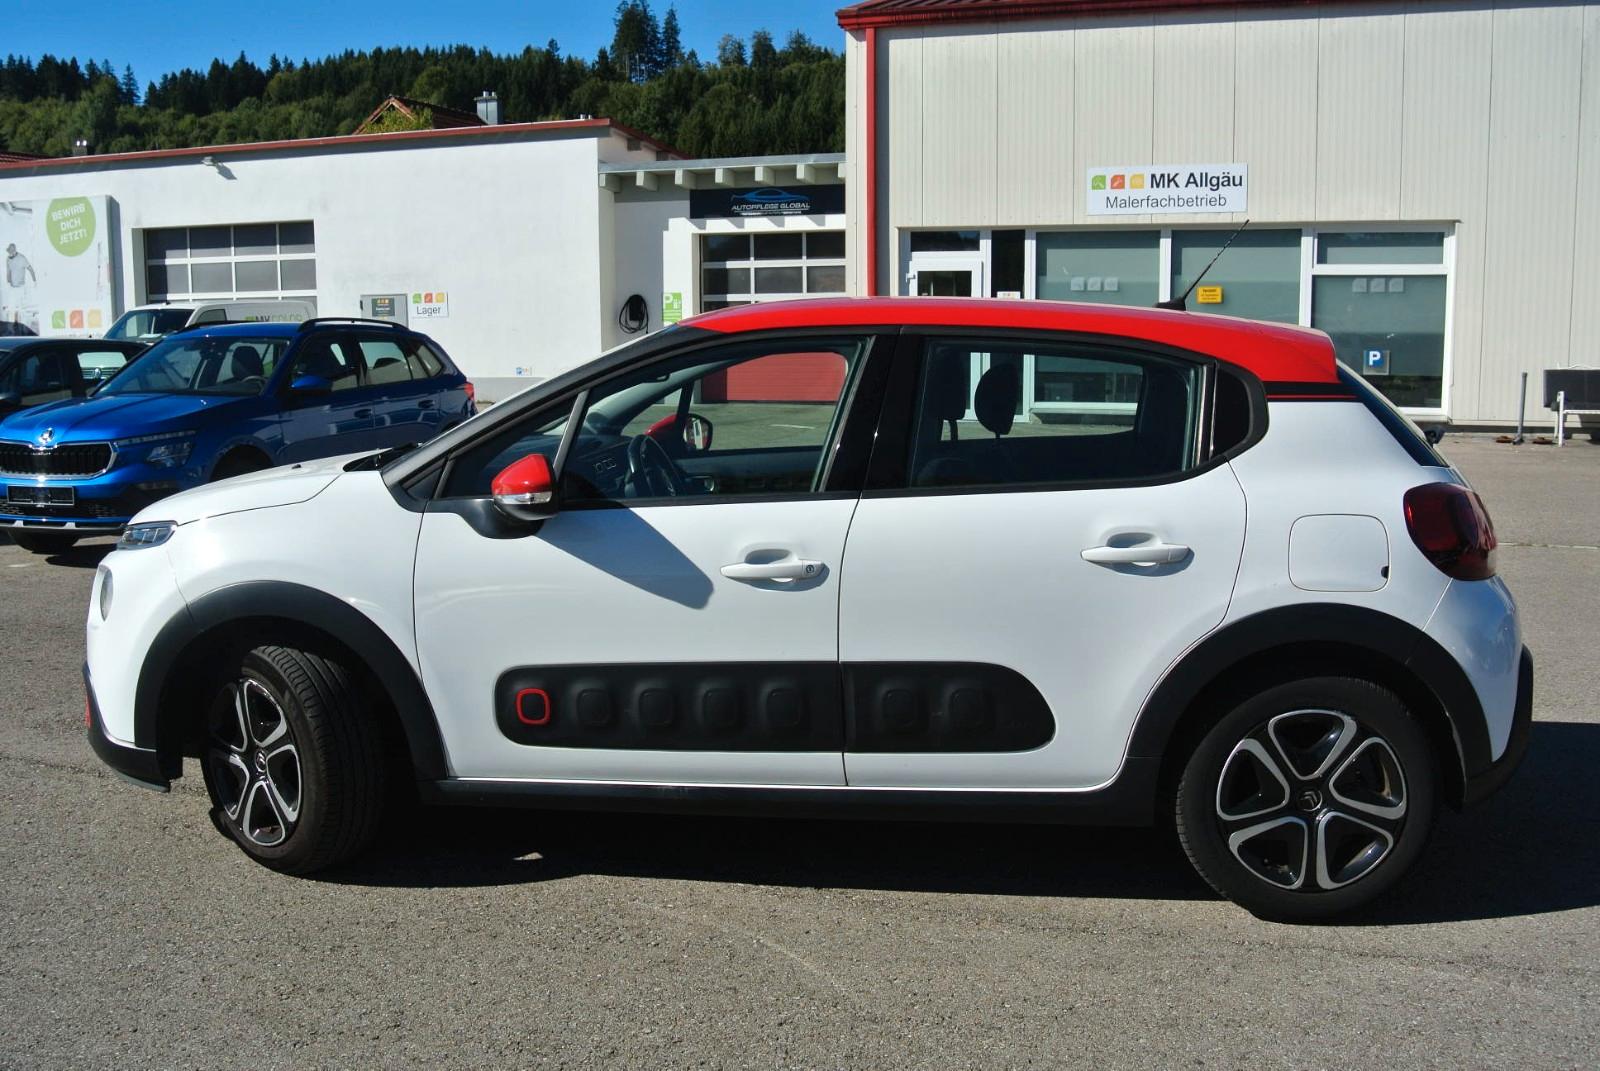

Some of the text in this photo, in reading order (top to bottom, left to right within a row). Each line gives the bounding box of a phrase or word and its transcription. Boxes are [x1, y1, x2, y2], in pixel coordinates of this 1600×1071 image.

[1150, 172, 1242, 191] MK Allgäu
[780, 202, 810, 210] GLOBAL
[1106, 194, 1227, 208] Malerfachbetrieb
[52, 203, 86, 221] BEWIRB
[60, 217, 81, 231] DICH
[60, 229, 87, 244] JETZT!
[416, 306, 442, 317] Lager
[1369, 351, 1381, 366] P
